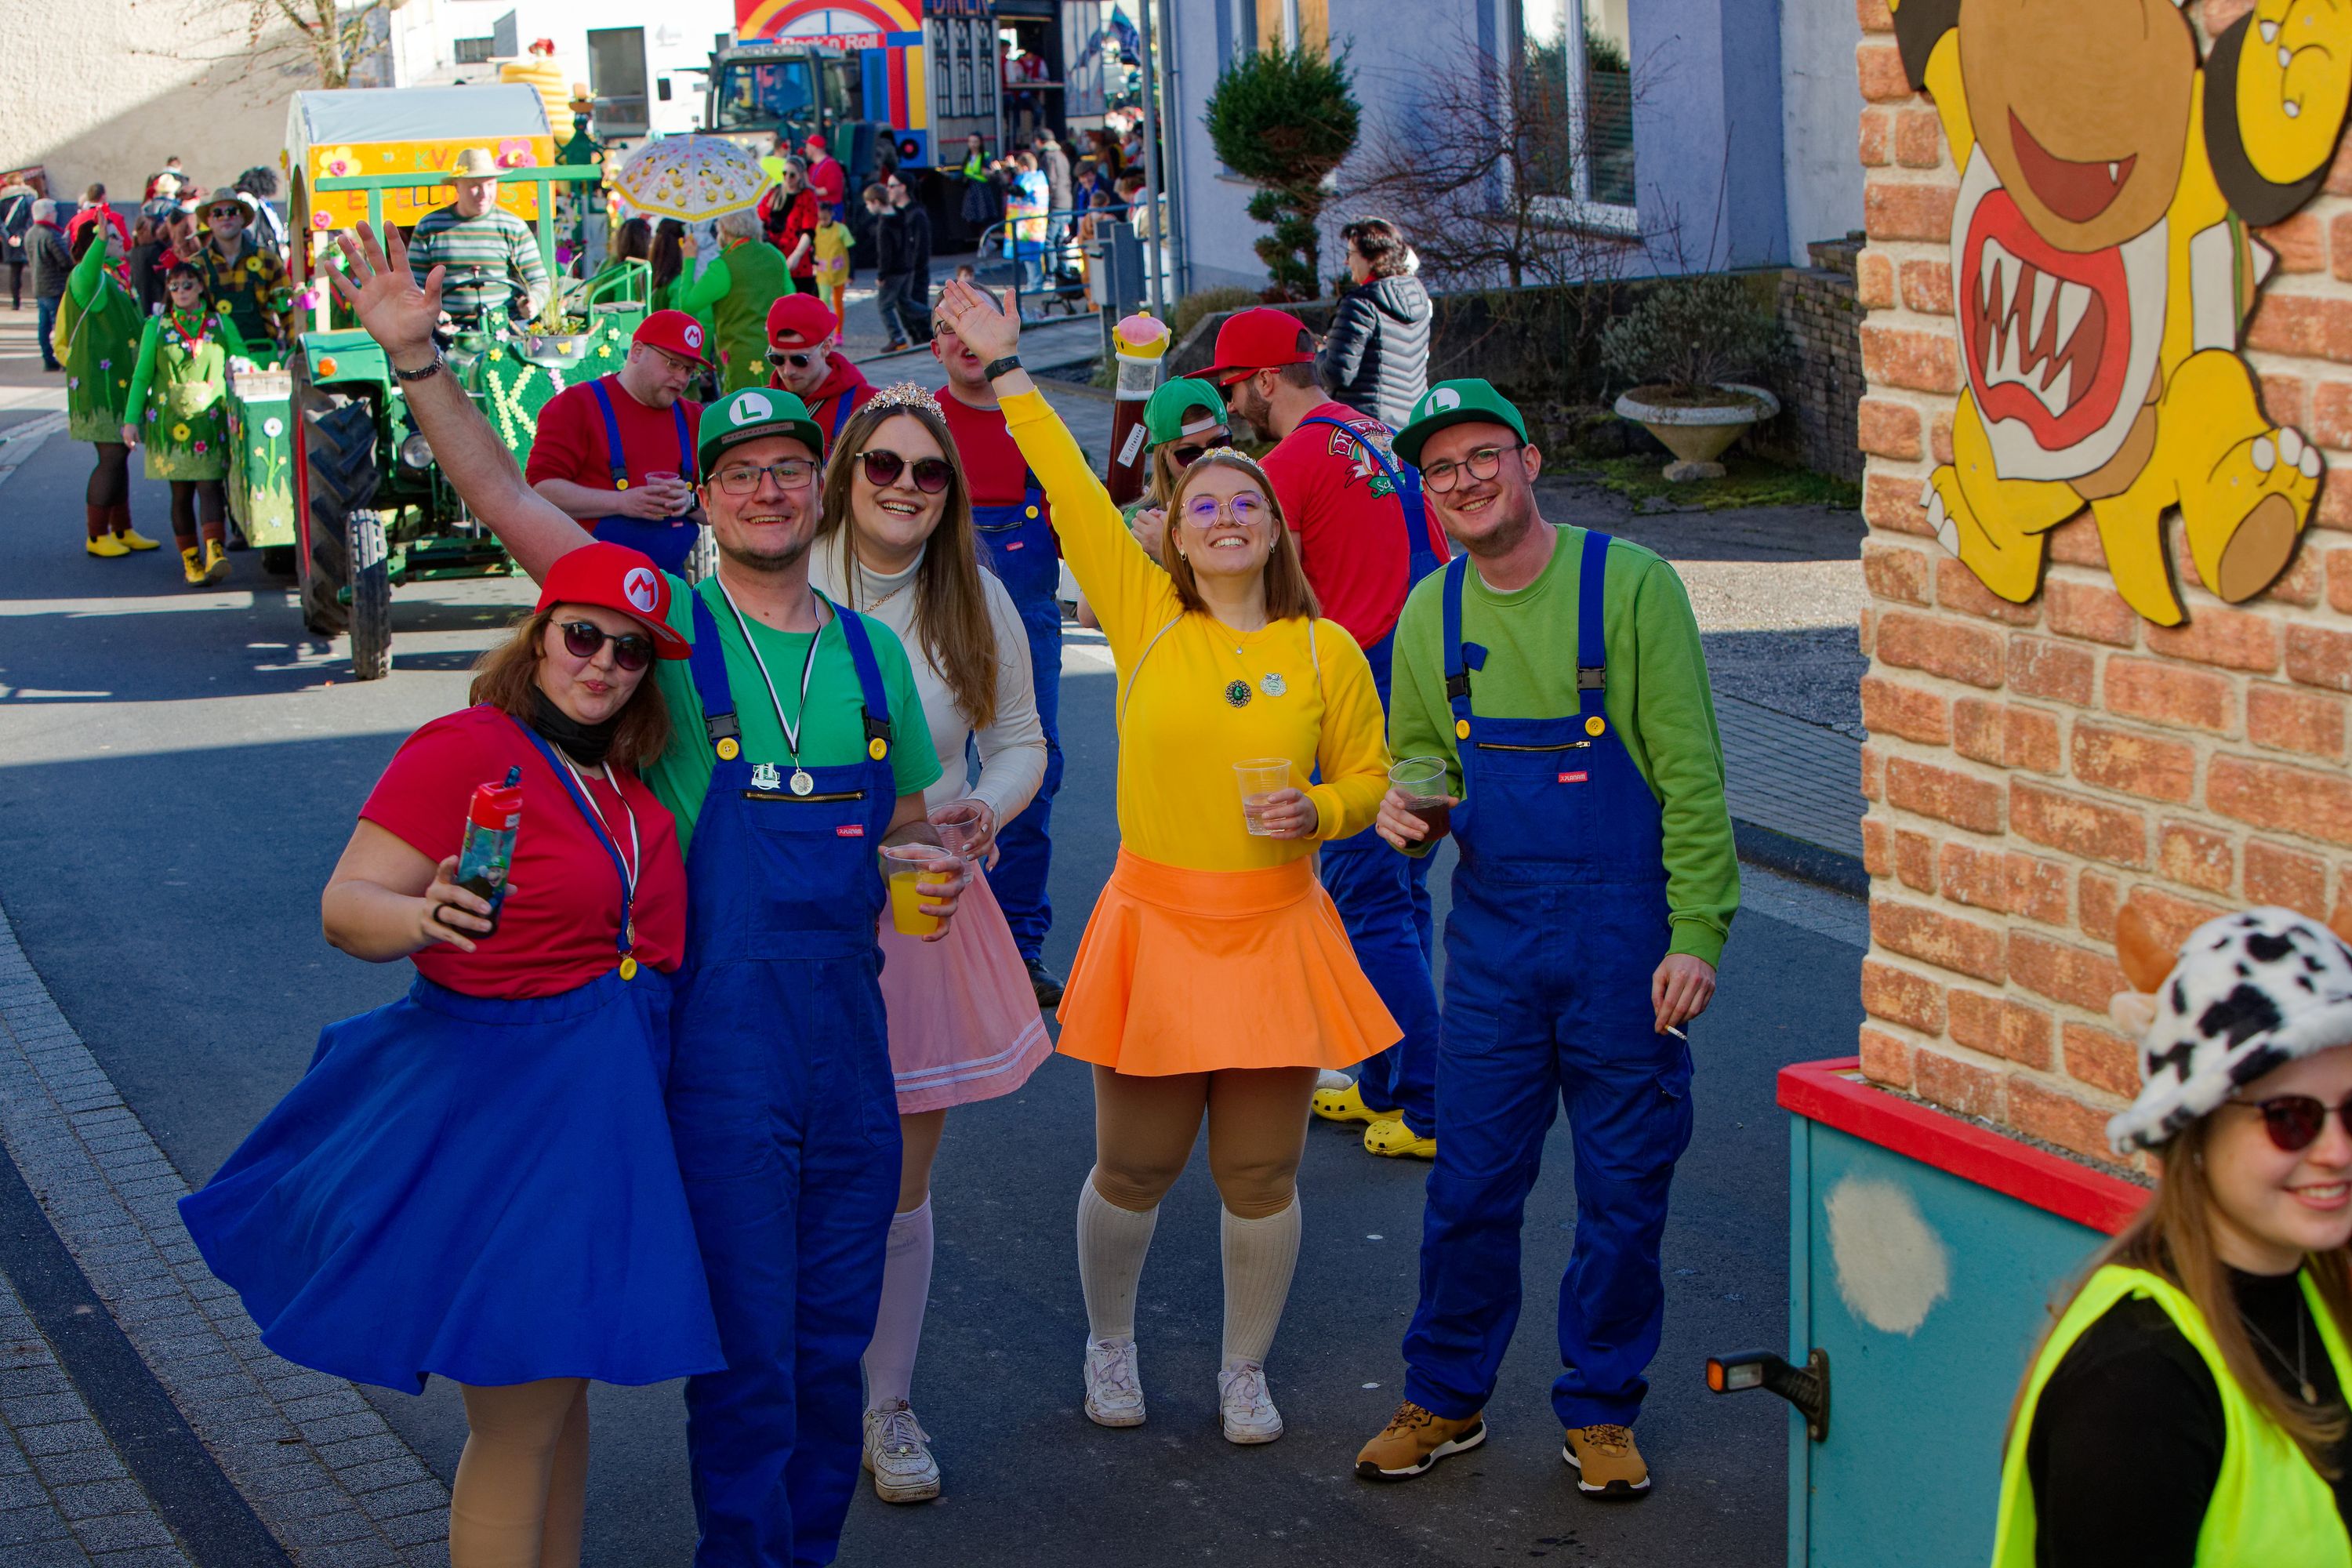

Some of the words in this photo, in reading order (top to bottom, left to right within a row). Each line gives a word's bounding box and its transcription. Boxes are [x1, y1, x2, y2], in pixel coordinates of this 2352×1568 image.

[688, 328, 699, 345] M
[739, 400, 762, 419] L
[1432, 395, 1450, 414] L
[629, 573, 655, 608] M
